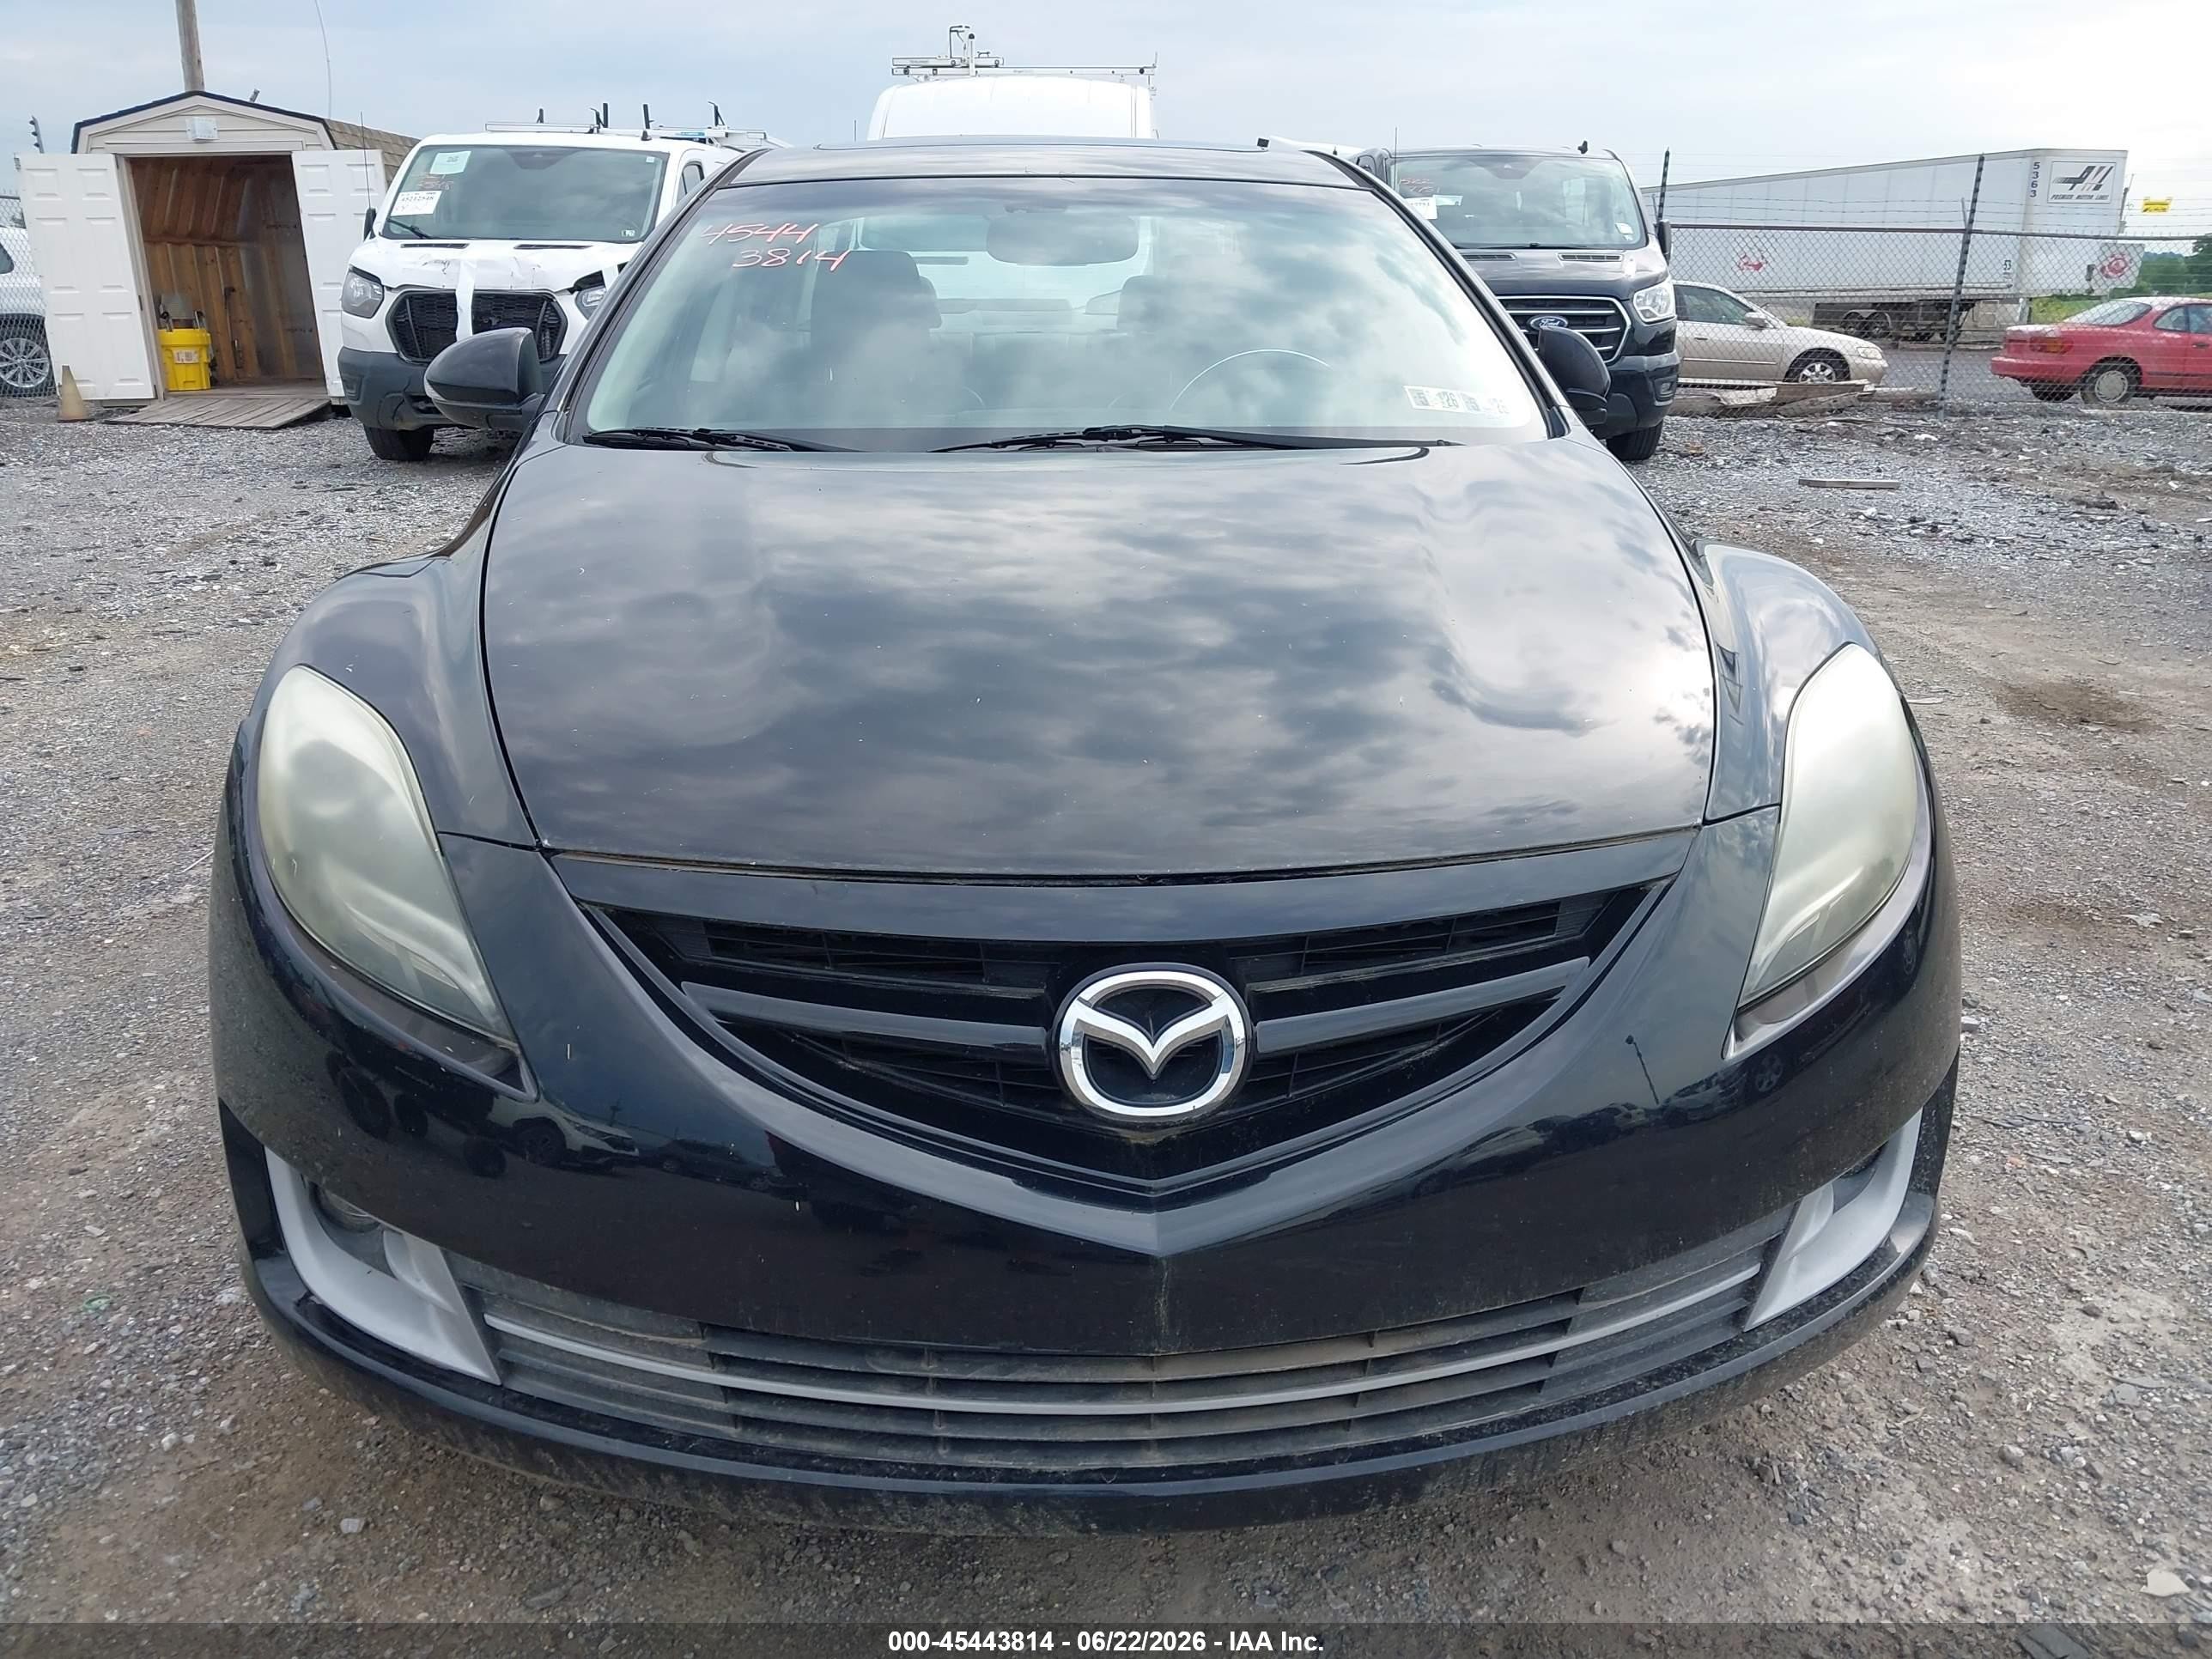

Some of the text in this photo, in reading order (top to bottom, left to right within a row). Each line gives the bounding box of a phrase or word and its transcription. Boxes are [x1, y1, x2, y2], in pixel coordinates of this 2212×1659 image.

[2029, 161, 2041, 198] 5363
[701, 222, 818, 245] 4544
[732, 247, 852, 272] 3814
